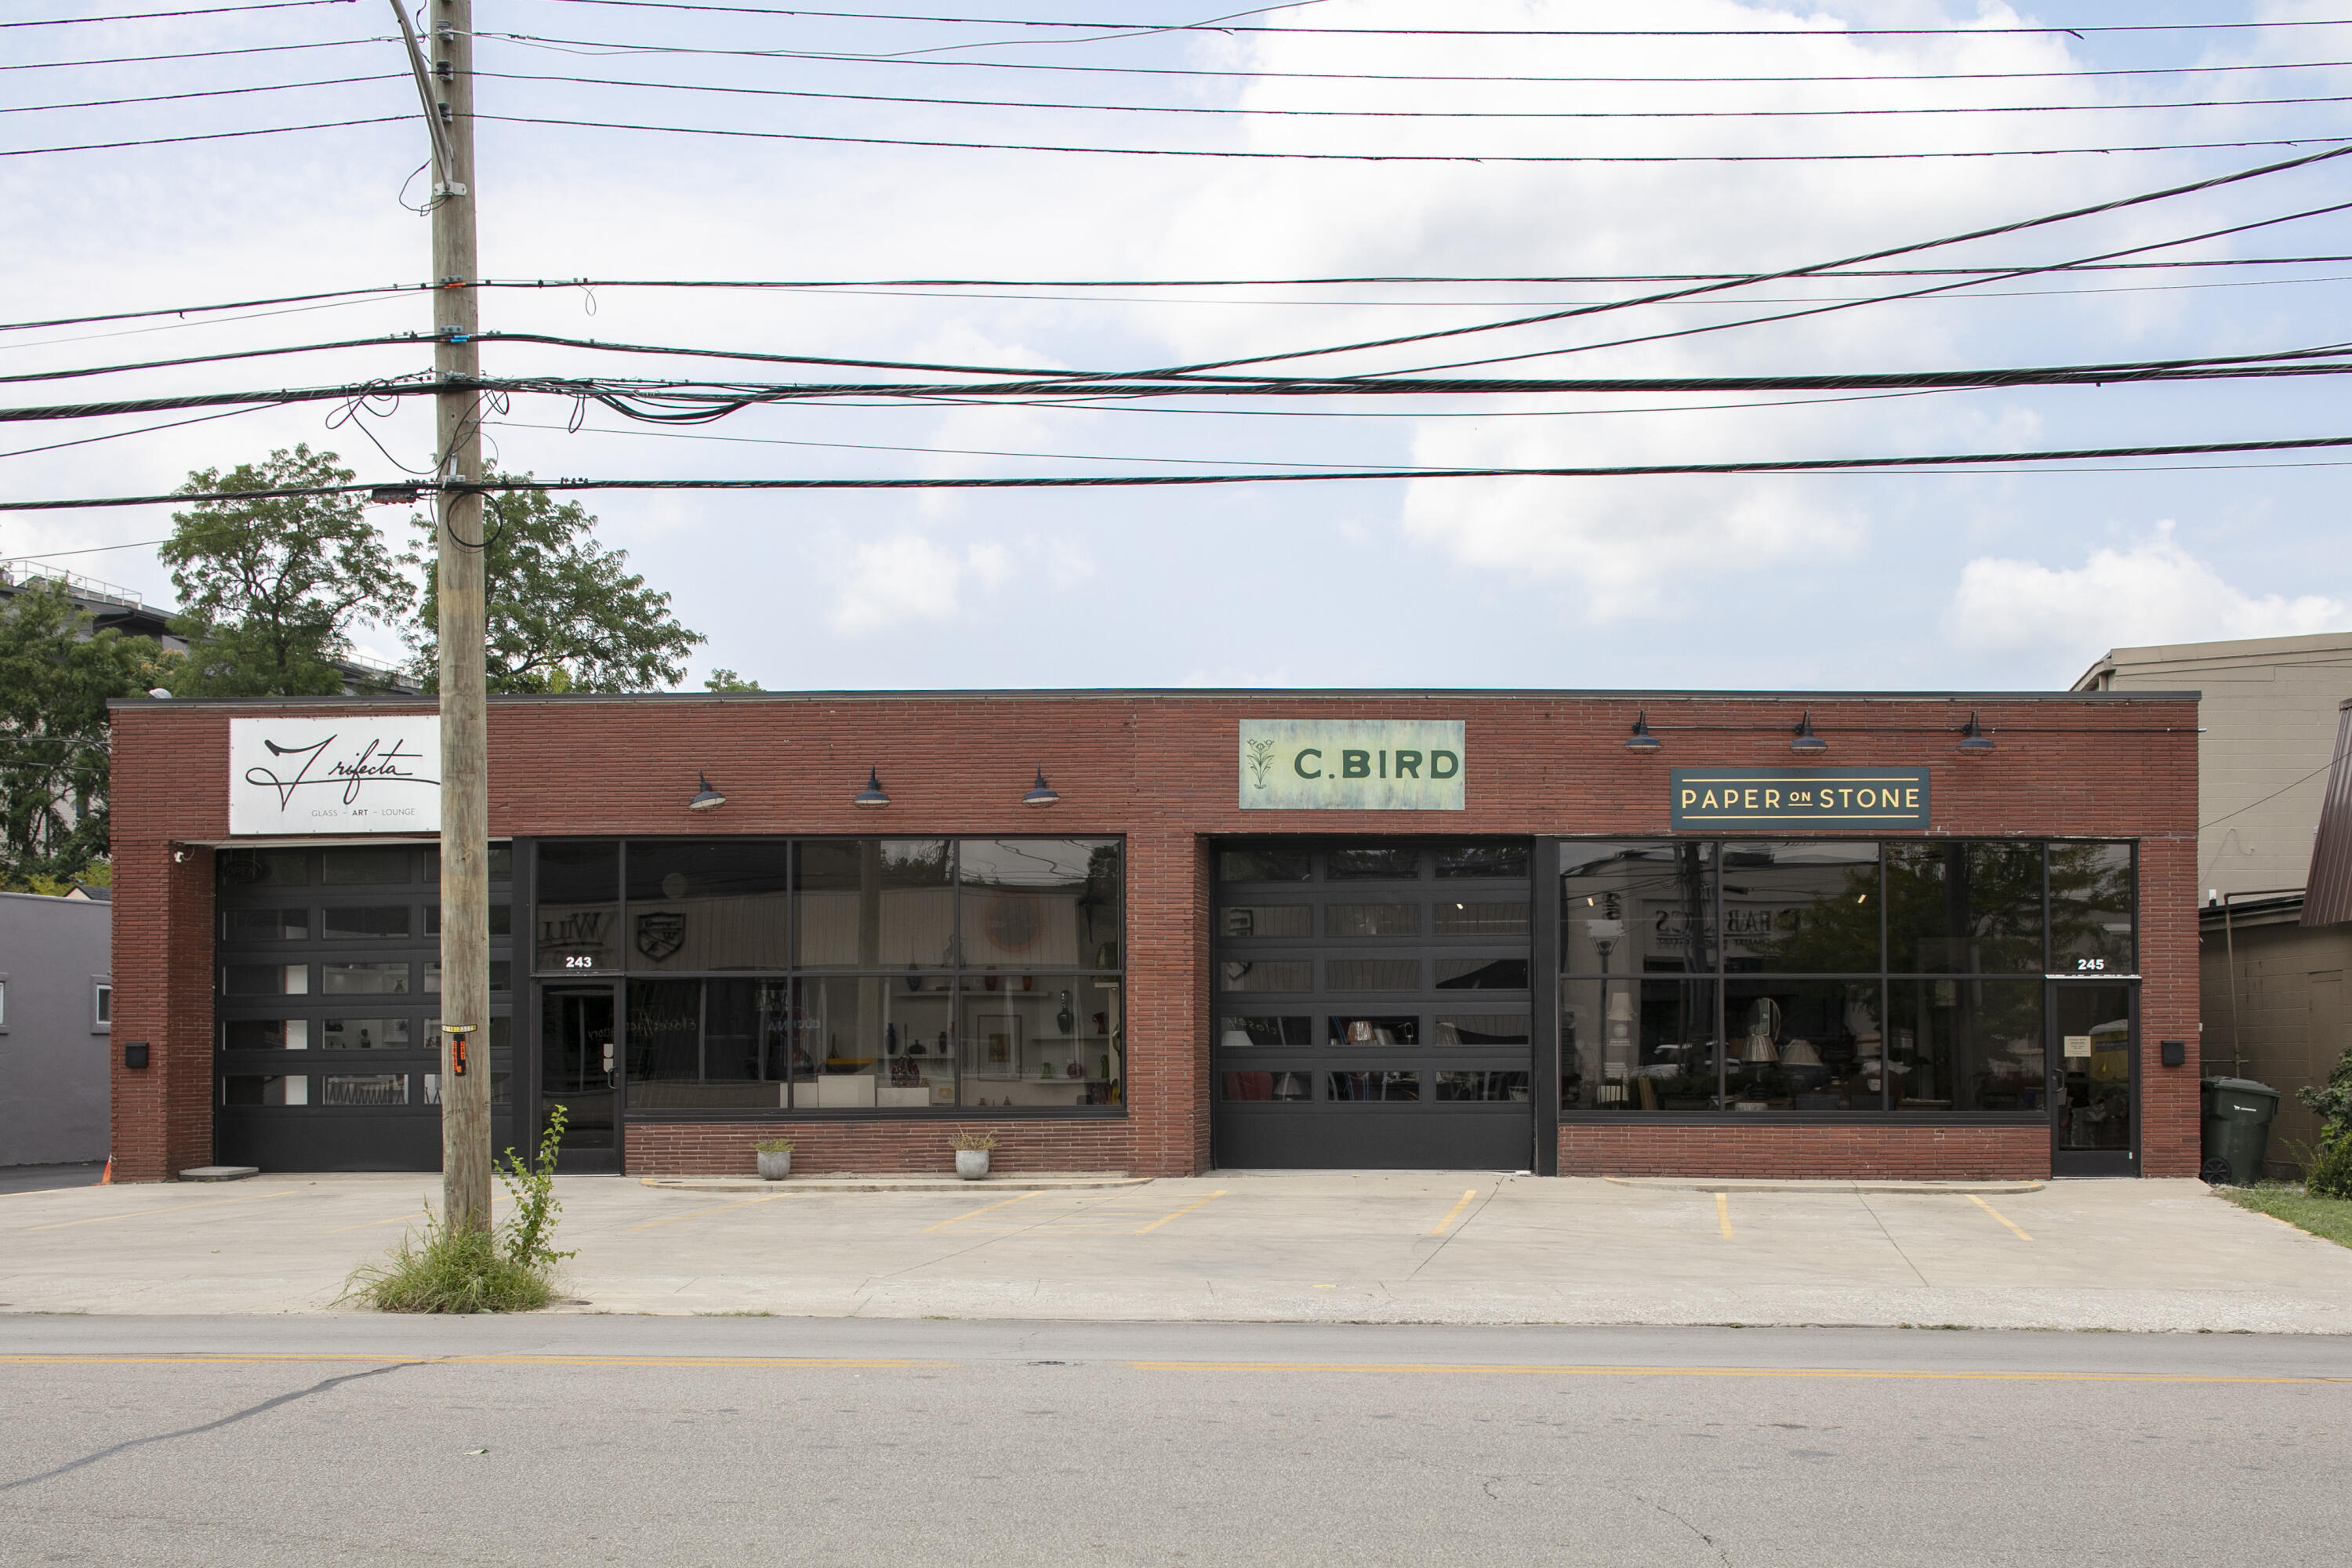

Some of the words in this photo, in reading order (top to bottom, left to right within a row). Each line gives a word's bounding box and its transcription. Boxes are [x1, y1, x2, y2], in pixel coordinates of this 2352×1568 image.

[245, 734, 441, 812] Trifecta
[1681, 789, 1780, 809] PAPER
[1789, 791, 1812, 802] ON
[1819, 788, 1920, 808] STONE
[382, 808, 416, 816] LOUNGE
[565, 956, 593, 968] 243
[2077, 958, 2105, 971] 245
